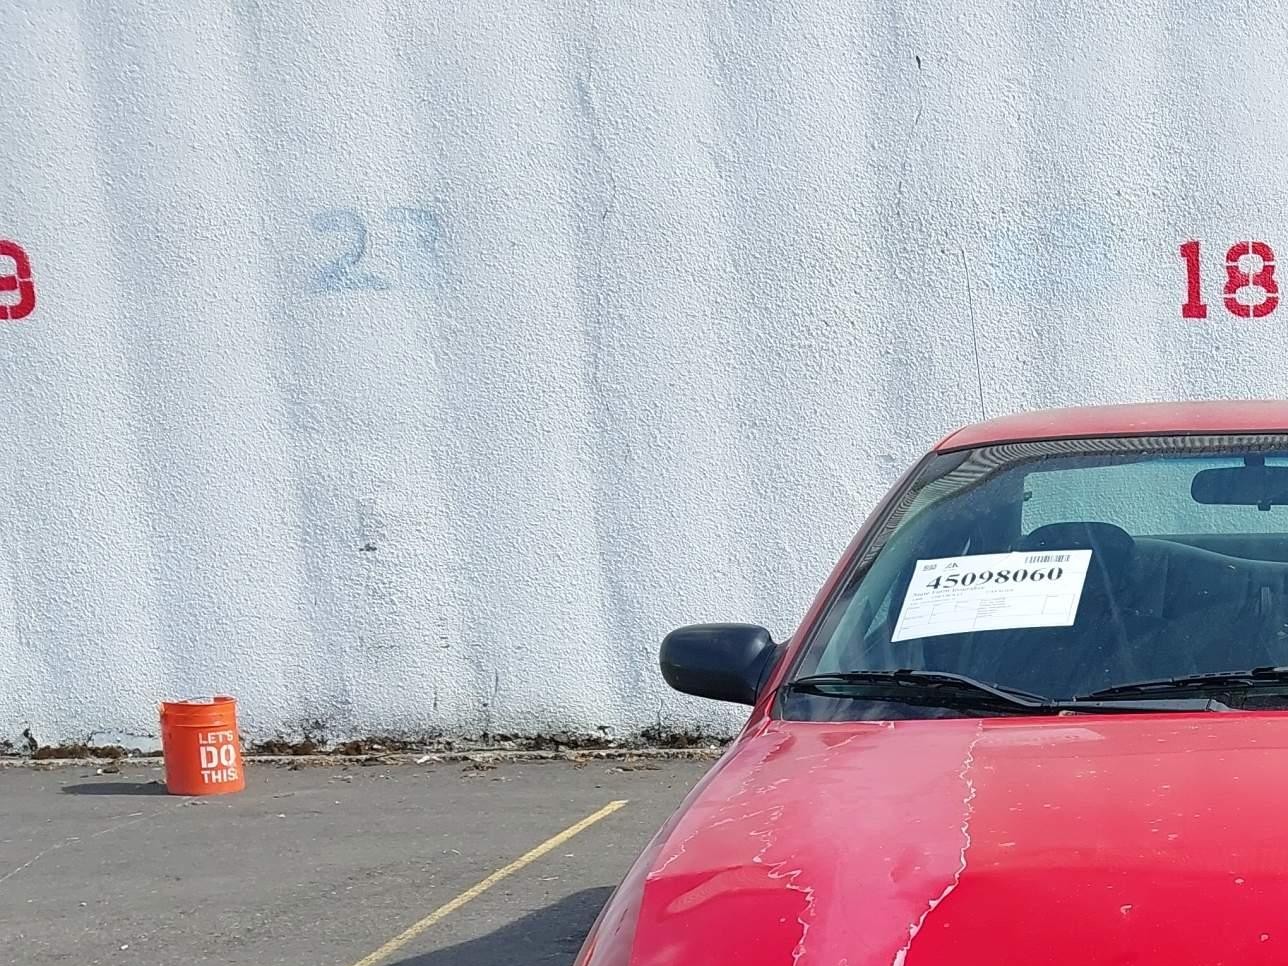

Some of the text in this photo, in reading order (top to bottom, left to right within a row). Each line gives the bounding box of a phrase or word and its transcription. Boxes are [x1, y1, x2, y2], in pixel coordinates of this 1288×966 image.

[1179, 240, 1280, 320] 18
[926, 566, 1064, 590] 45098060
[198, 730, 234, 745] LET'S
[199, 744, 237, 769] DO
